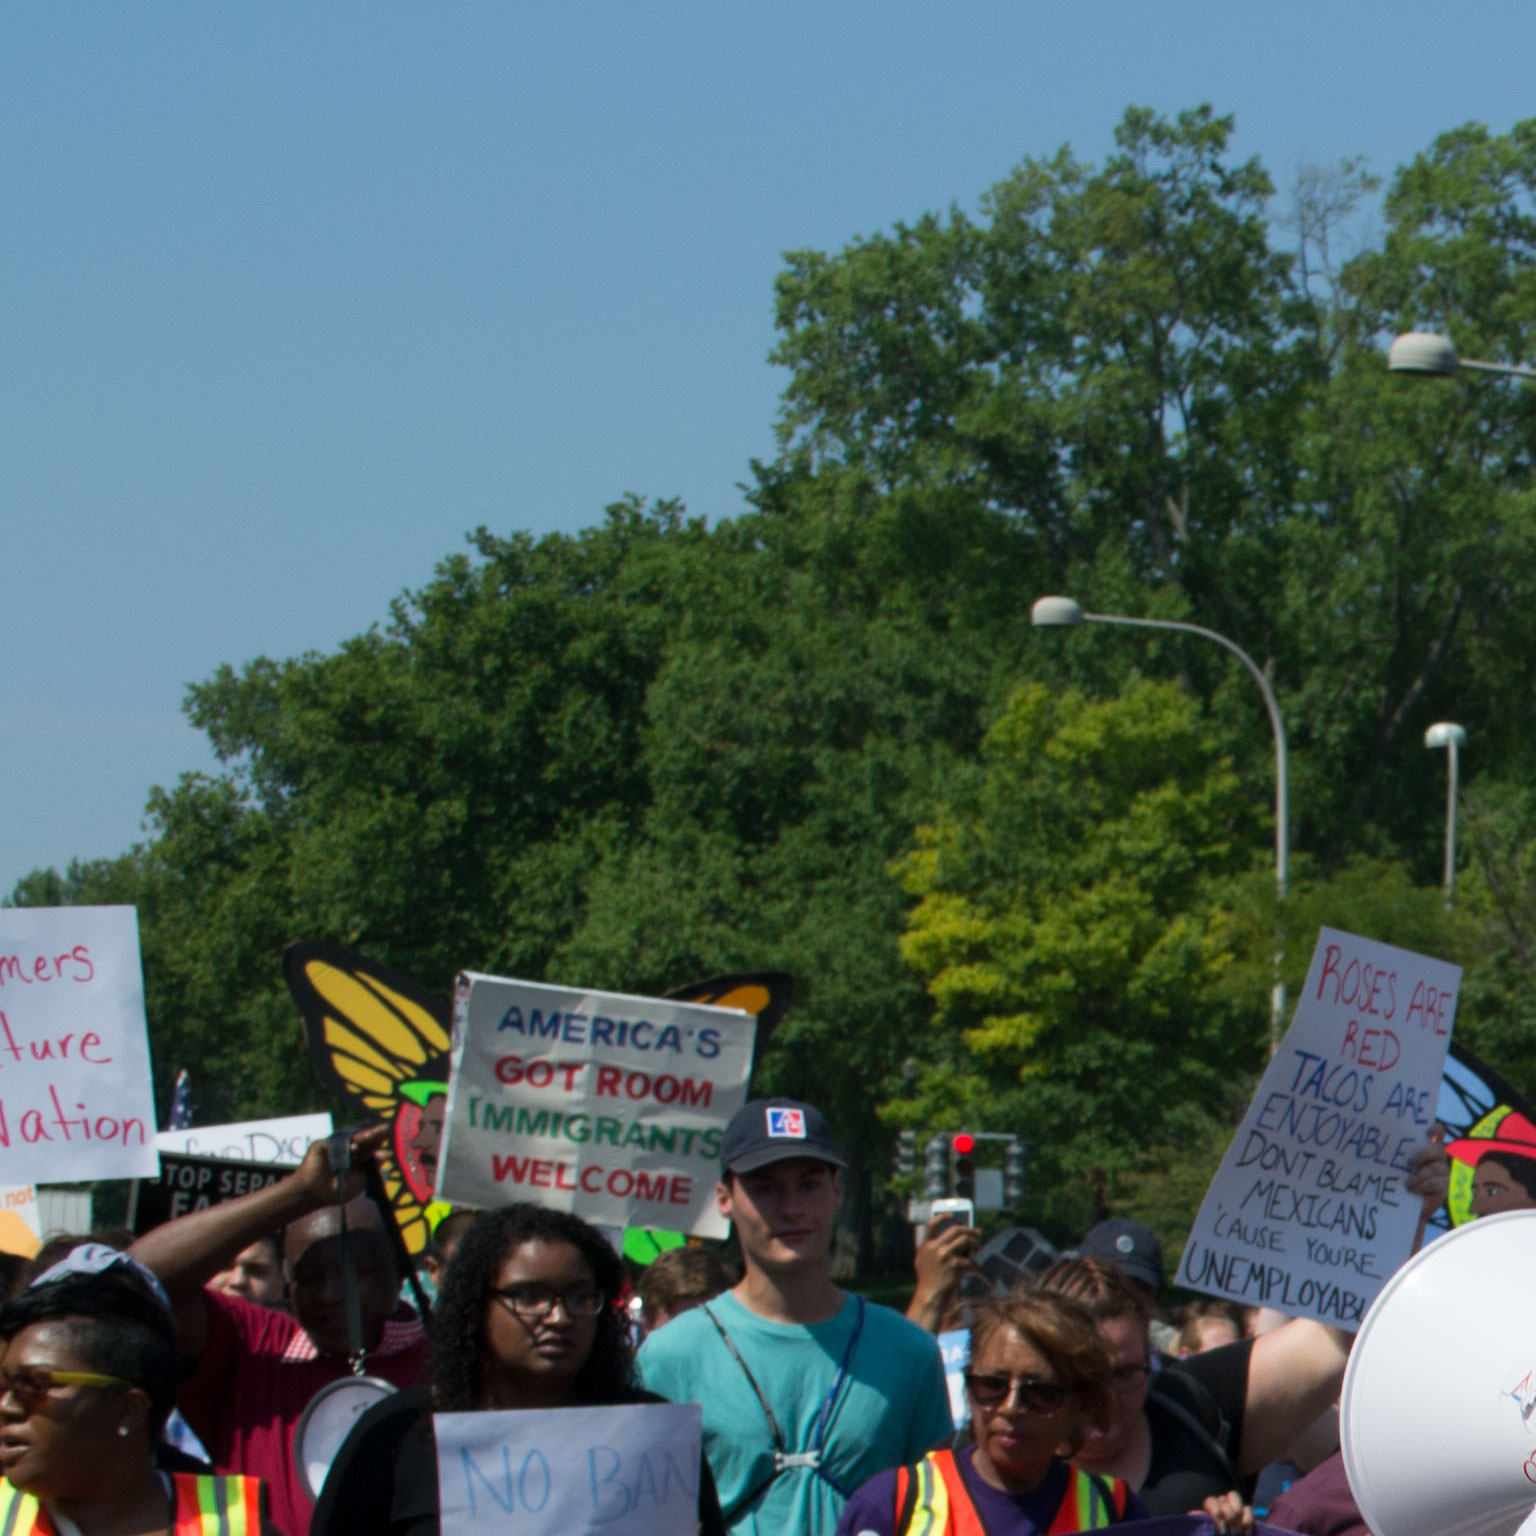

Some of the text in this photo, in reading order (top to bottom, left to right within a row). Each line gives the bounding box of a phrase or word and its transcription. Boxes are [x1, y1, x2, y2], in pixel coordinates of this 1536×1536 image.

[1316, 945, 1452, 1035] ROSES ARE
[498, 1006, 721, 1058] AMERICA'S
[1341, 1020, 1401, 1072] RED
[495, 1055, 713, 1107] GOT ROOM
[1291, 1050, 1430, 1125] TACOS ARE
[467, 1096, 725, 1160] IMMIGRANTS
[1256, 1092, 1415, 1174] ENJOYABLE
[150, 1163, 214, 1190] TOP
[492, 1154, 693, 1204] WELCOME
[1317, 1159, 1400, 1207] BLAME
[1240, 1179, 1378, 1240] MEXICANS
[459, 1445, 552, 1517] NO
